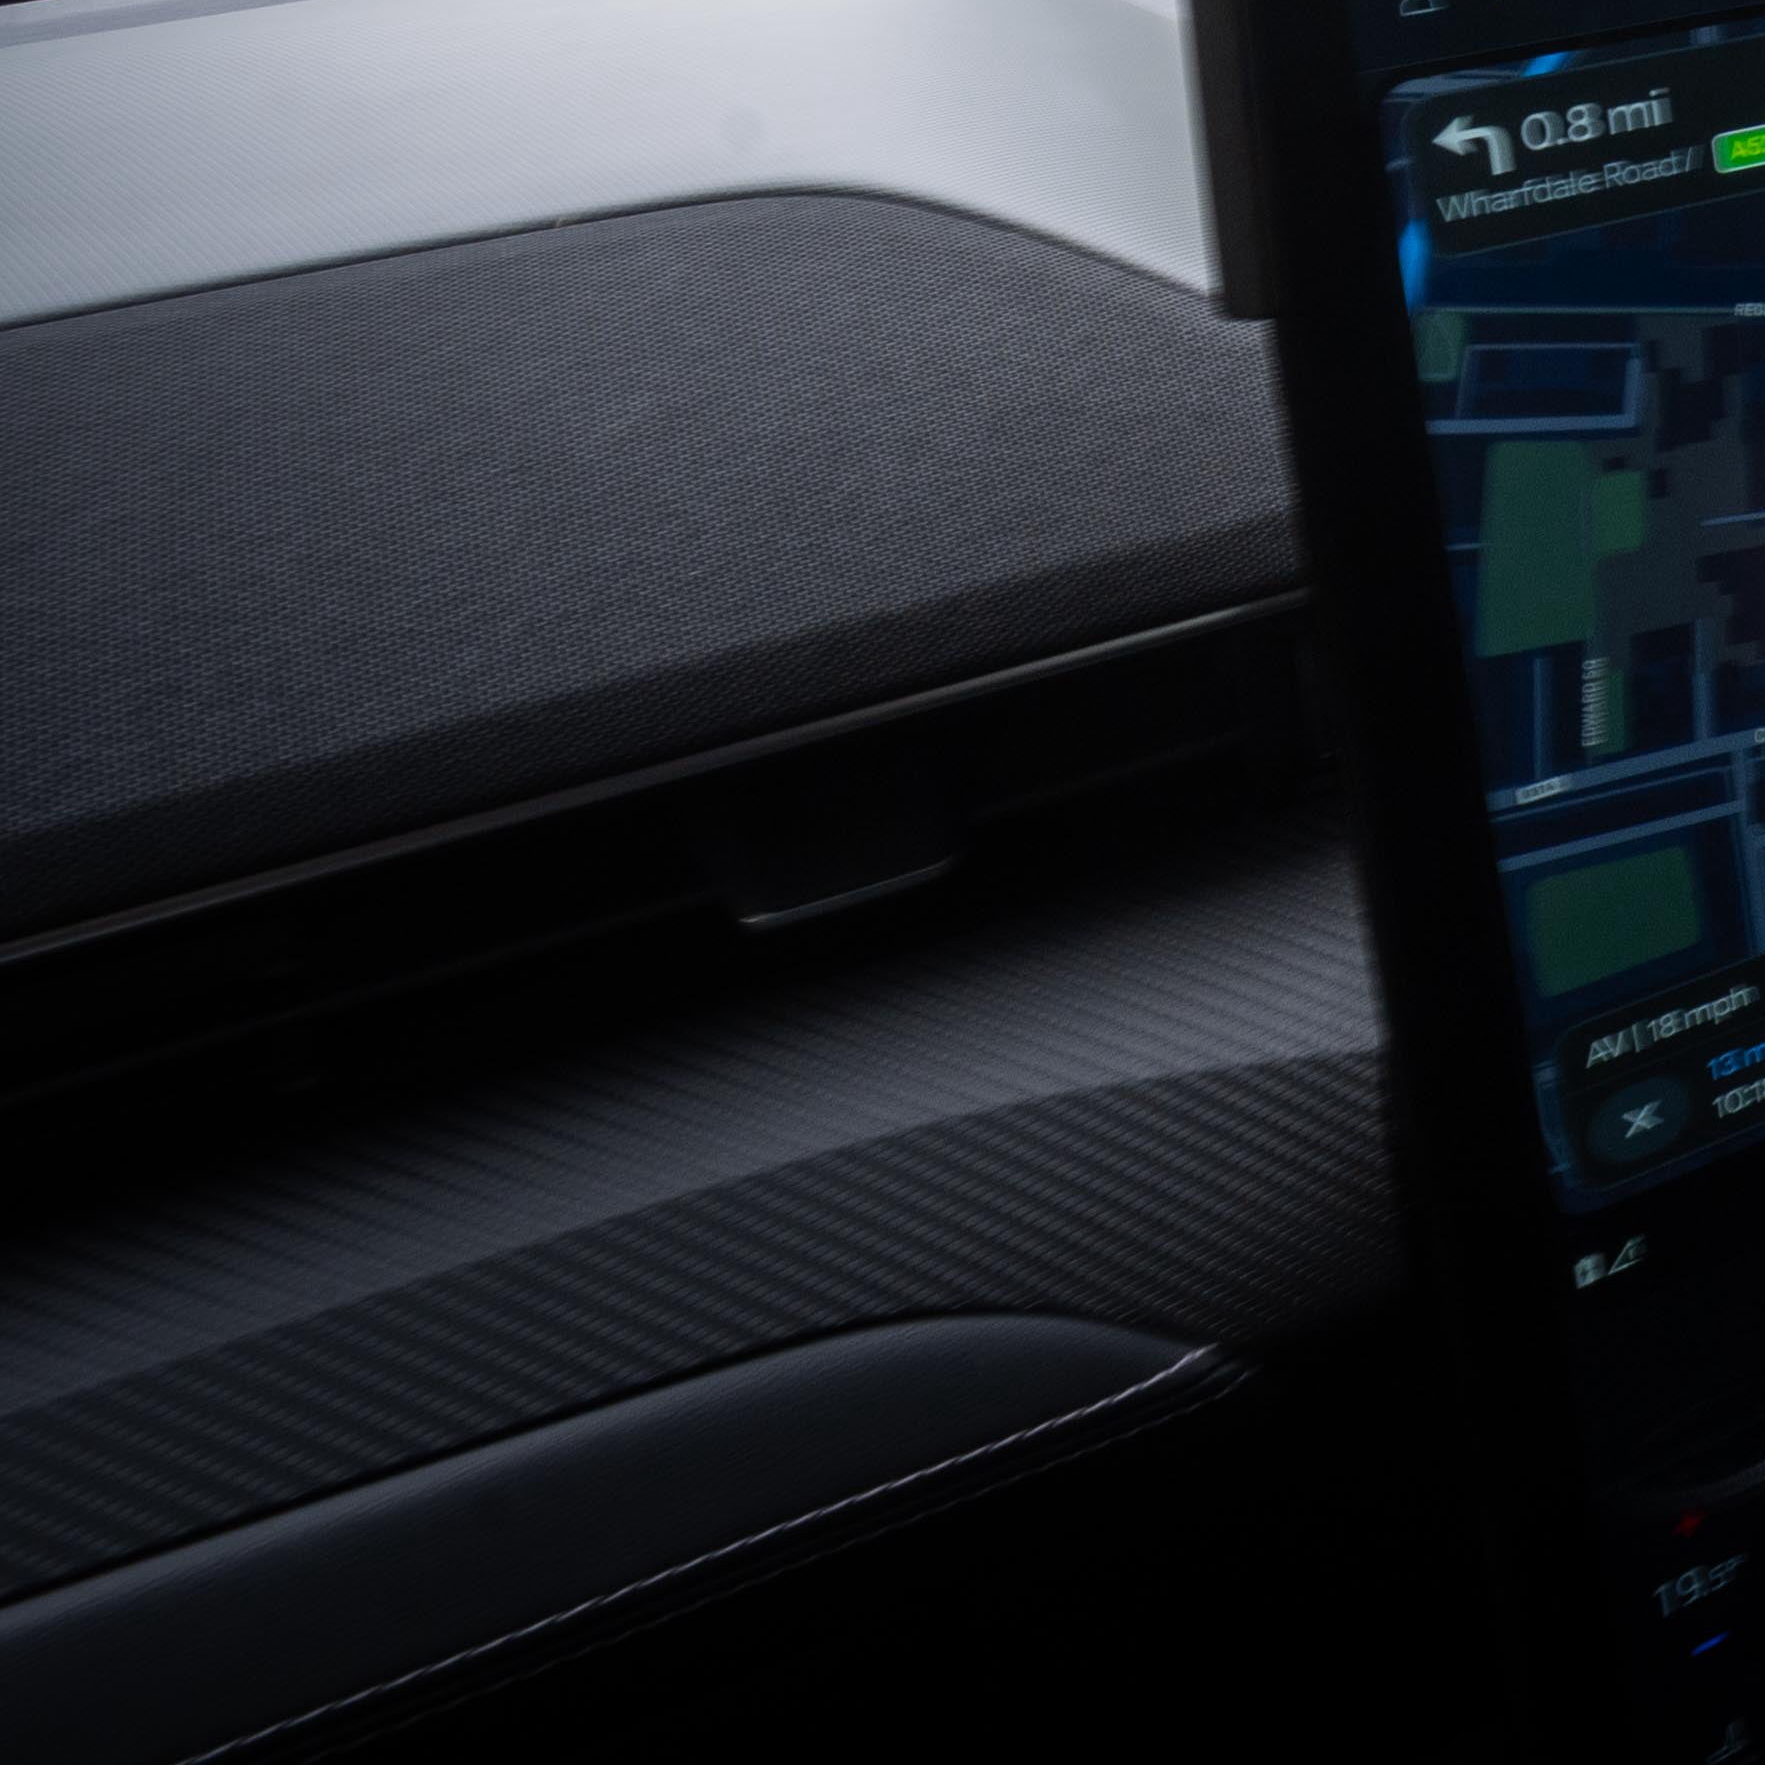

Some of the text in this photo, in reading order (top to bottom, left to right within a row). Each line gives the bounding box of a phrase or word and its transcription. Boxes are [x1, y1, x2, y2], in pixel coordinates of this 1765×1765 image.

[1520, 101, 1604, 152] 0.8
[1436, 167, 1601, 223] Wharfdale
[1603, 148, 1682, 190] Road
[1585, 1034, 1631, 1069] AV
[1684, 984, 1759, 1030] mph
